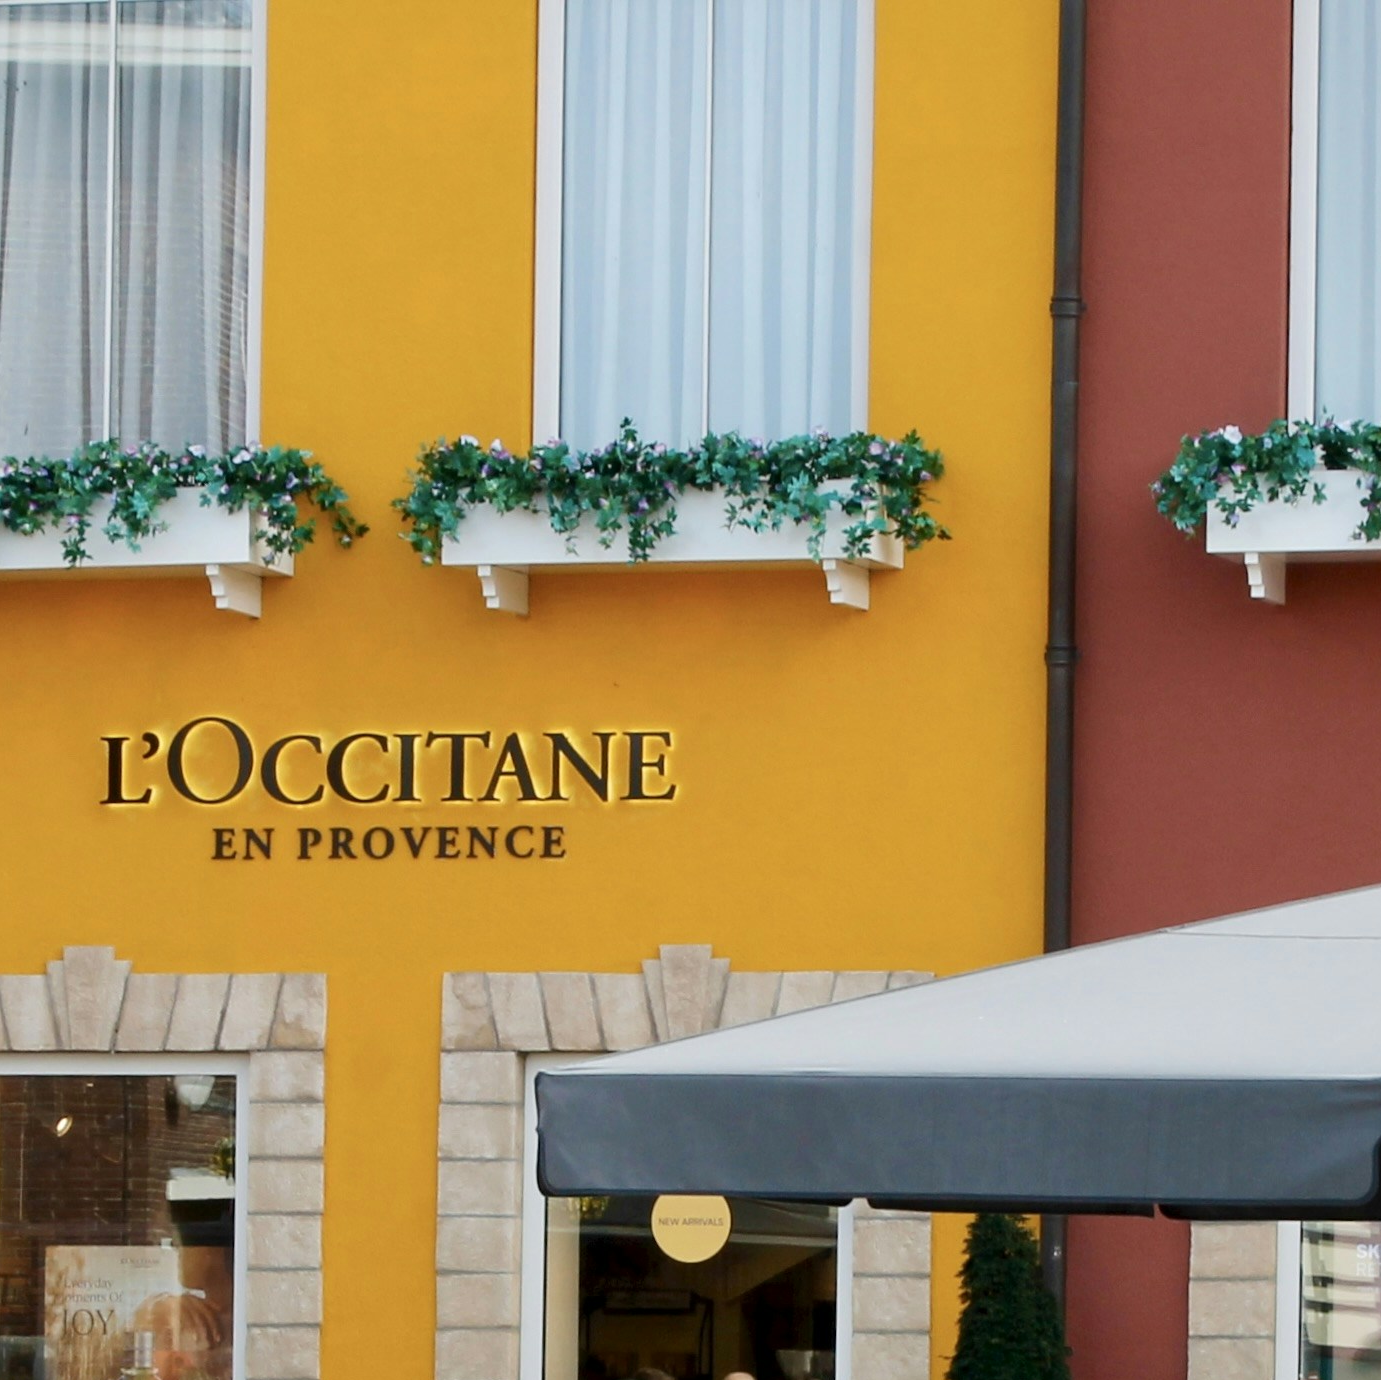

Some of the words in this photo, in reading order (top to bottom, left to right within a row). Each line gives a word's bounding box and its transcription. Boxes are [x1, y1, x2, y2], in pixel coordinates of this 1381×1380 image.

[99, 716, 678, 805] L'OCCITANE
[211, 827, 275, 861] EN
[297, 825, 568, 861] PROVENCE
[658, 1217, 680, 1226] NEW
[682, 1217, 724, 1226] ARRIVALS
[61, 1292, 107, 1303] oments
[62, 1308, 115, 1338] JOY
